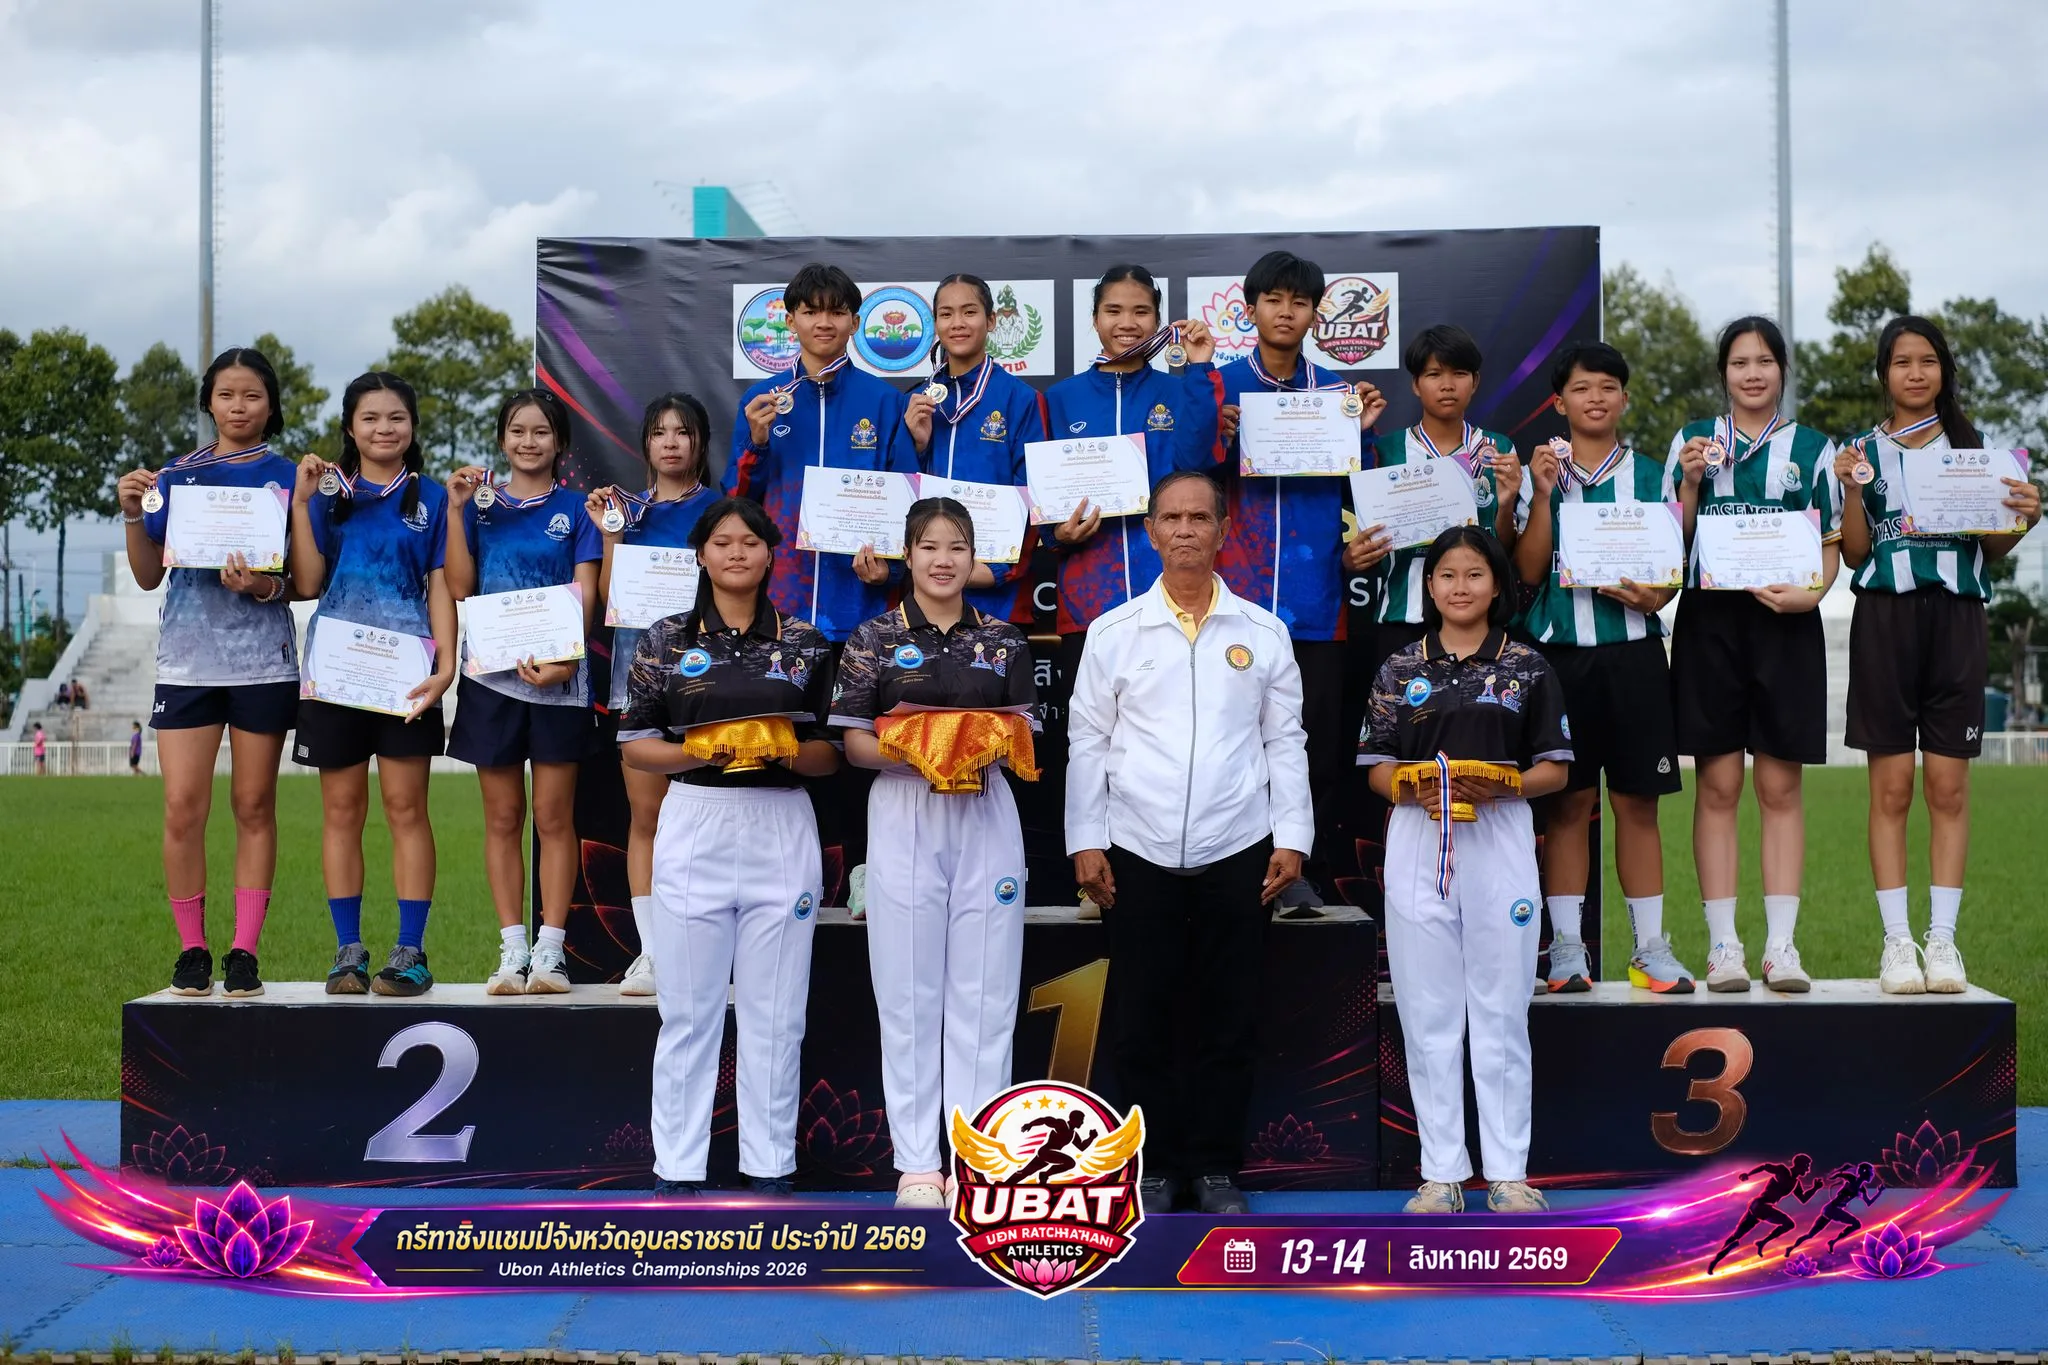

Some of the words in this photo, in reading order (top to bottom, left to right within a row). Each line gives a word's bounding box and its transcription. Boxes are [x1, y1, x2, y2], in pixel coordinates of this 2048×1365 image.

[1318, 322, 1384, 340] UBAT
[1027, 958, 1110, 1090] 1
[363, 1021, 480, 1163] 2
[1651, 1026, 1754, 1156] 3
